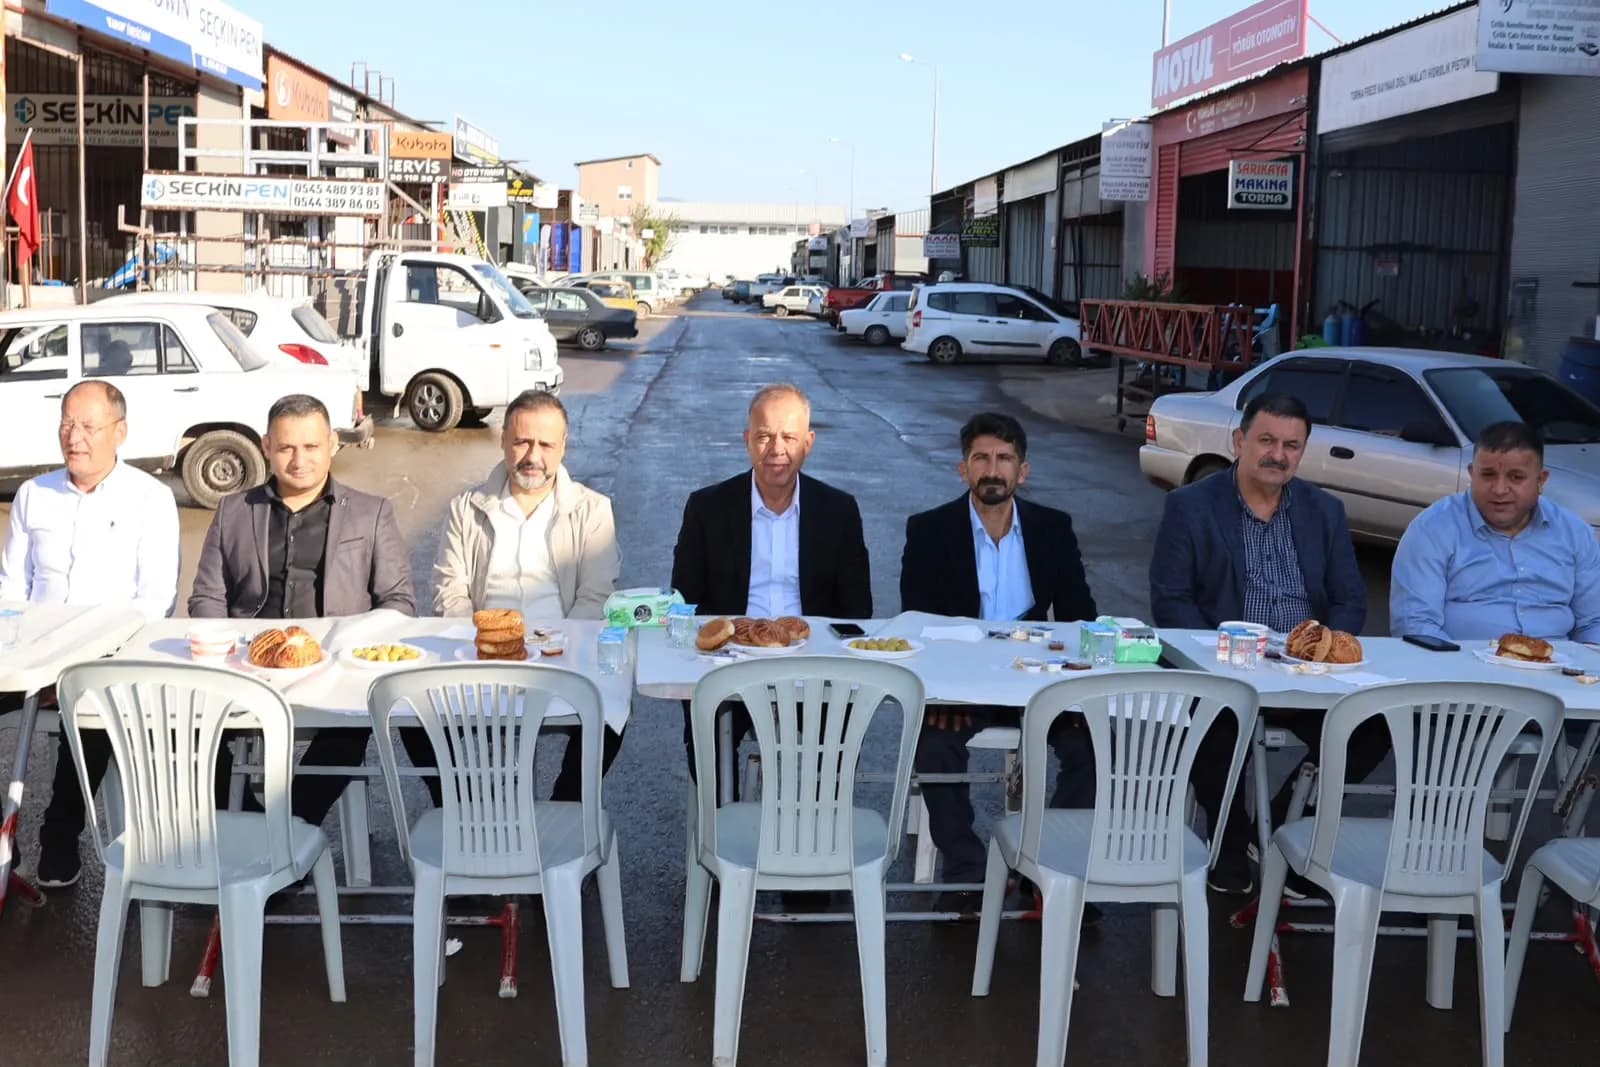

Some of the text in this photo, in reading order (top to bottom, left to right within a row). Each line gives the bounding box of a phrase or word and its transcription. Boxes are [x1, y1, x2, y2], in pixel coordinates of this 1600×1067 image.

[1154, 15, 1297, 98] MOTUL YÖRÜK OTOMOTİV
[42, 99, 143, 126] SEÇKİN
[396, 136, 447, 151] Kubota
[1238, 163, 1289, 176] SARIKAYA
[169, 179, 288, 198] SEÇKİN PEN
[295, 182, 380, 196] 0545 480 93 81
[294, 196, 322, 207] 0544
[325, 197, 346, 208] 389
[366, 199, 381, 210] 05
[1240, 193, 1283, 204] TORNA
